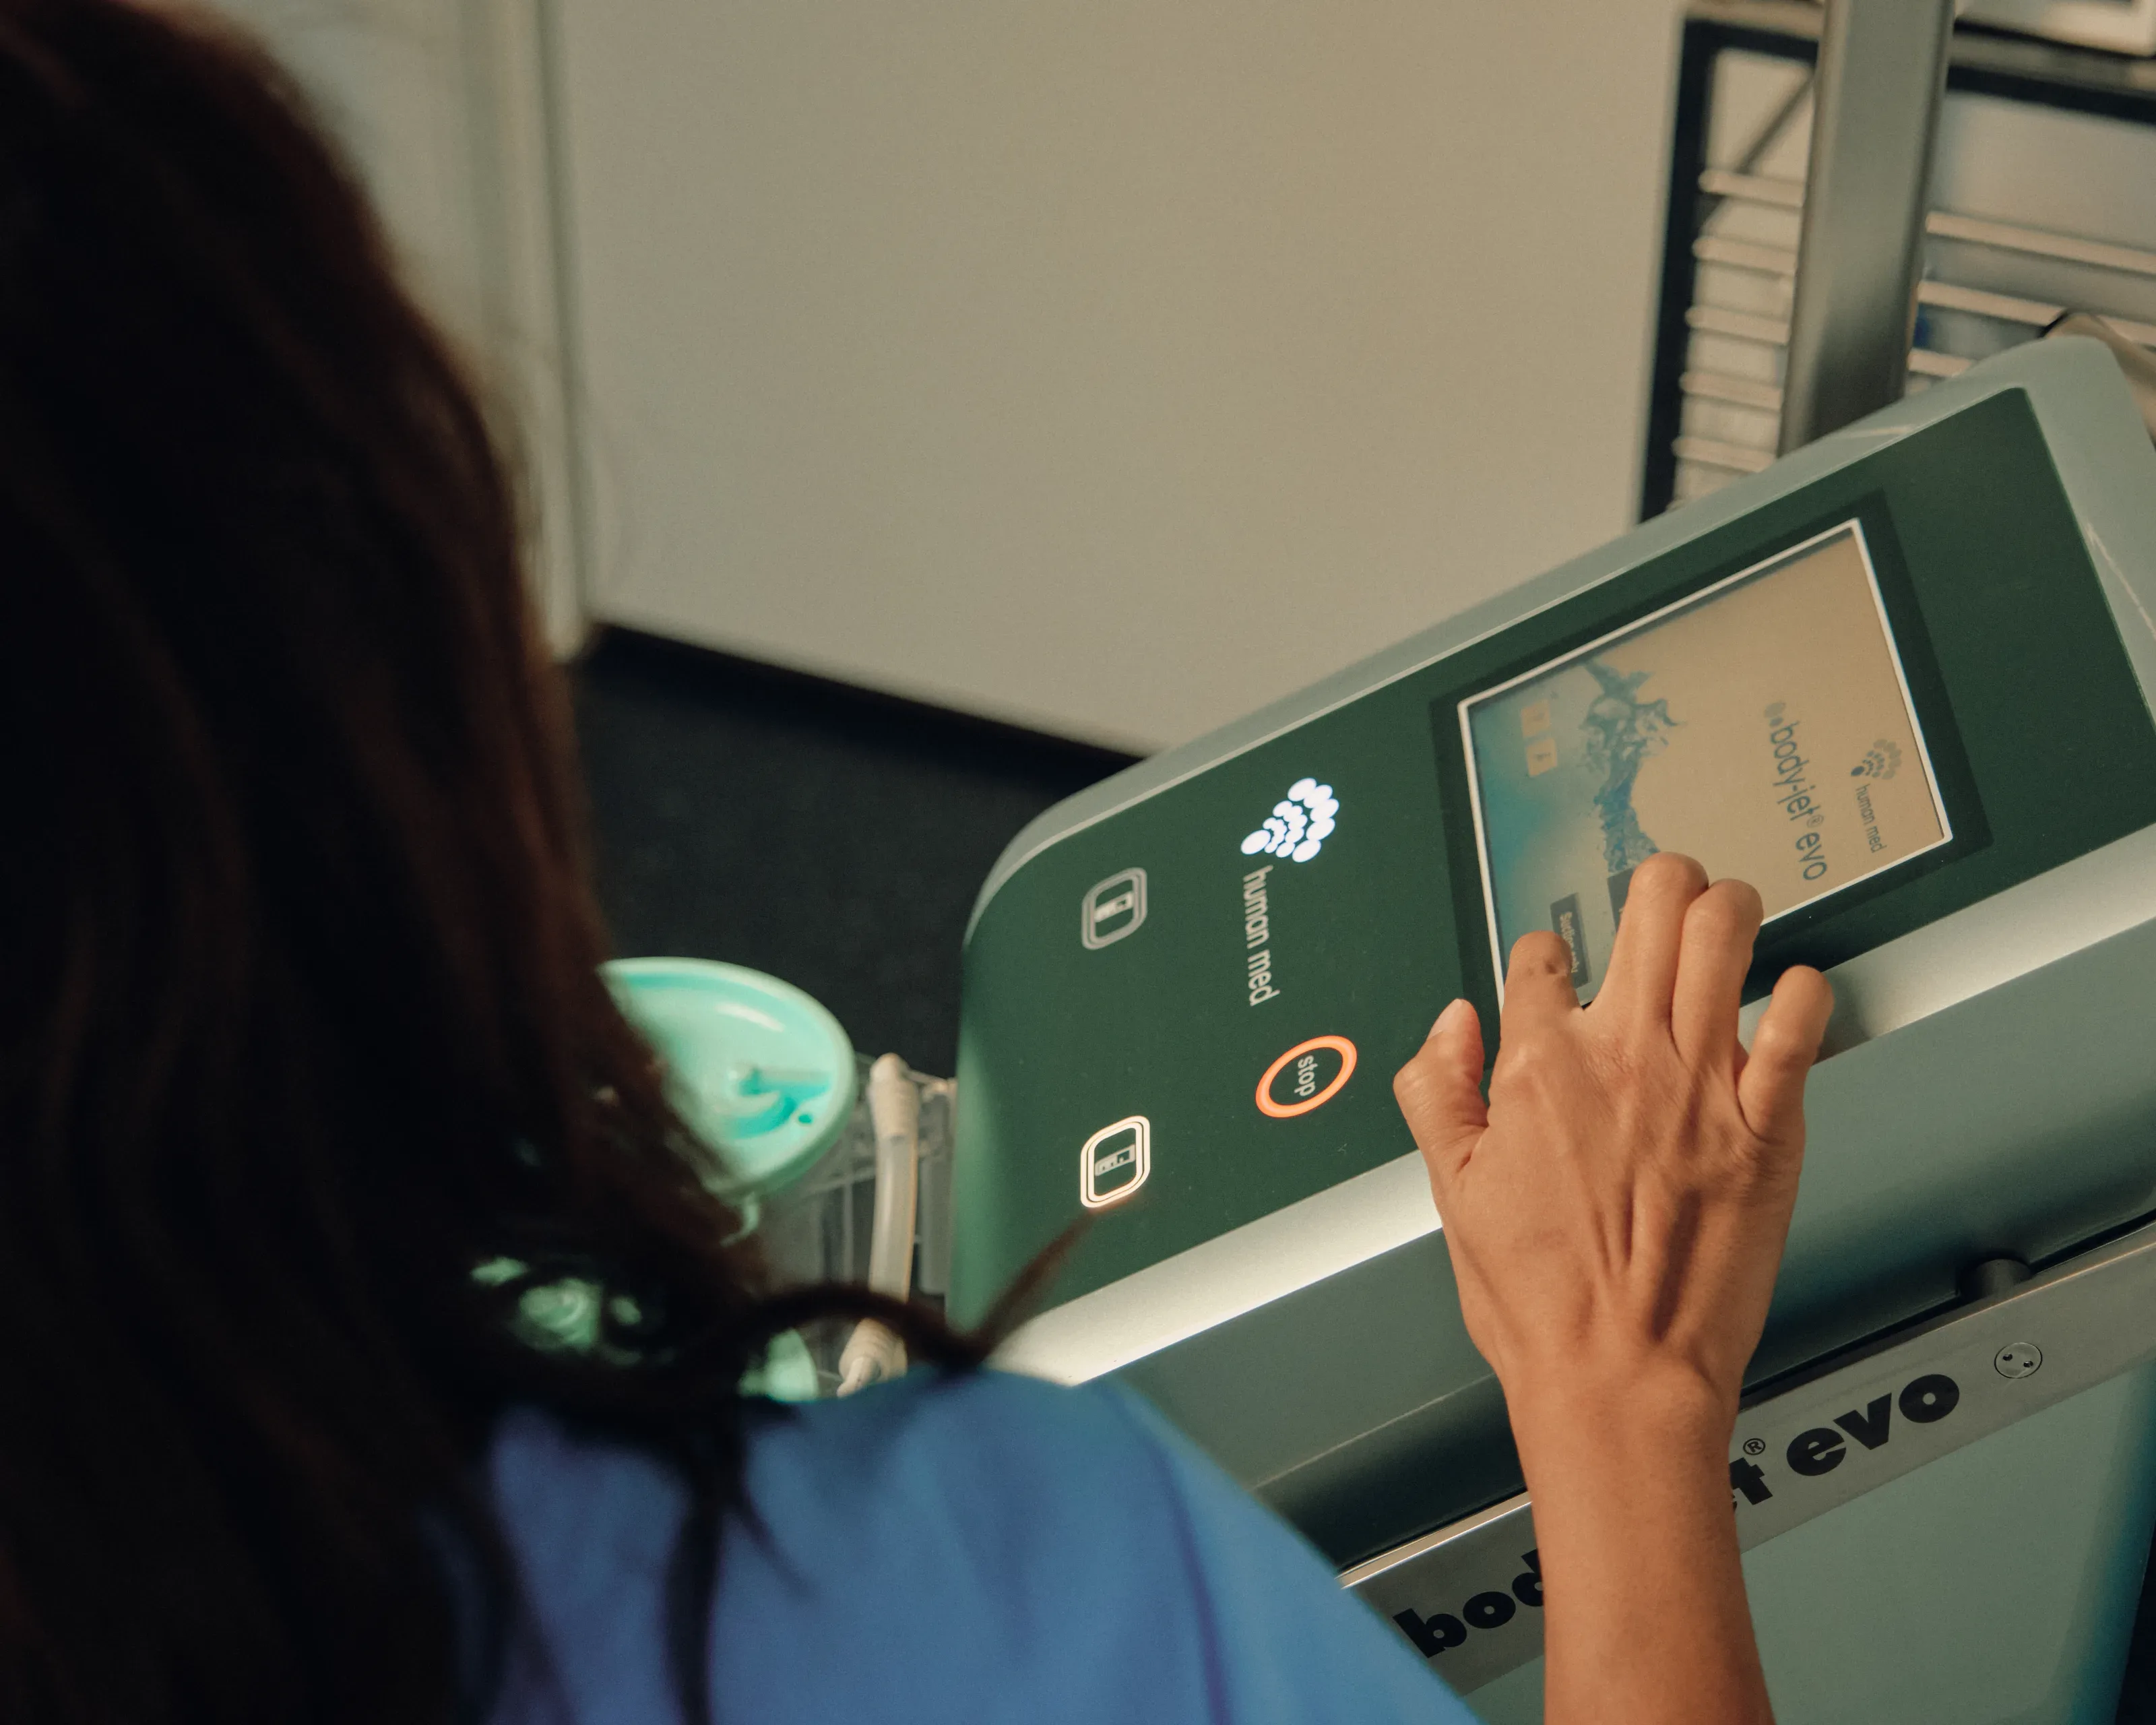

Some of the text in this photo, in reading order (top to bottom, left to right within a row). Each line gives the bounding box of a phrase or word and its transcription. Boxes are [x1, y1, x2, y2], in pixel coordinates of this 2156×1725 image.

[1856, 783, 1887, 854] human med
[1795, 832, 1828, 881] evo
[1242, 864, 1281, 1007] human med
[1294, 1055, 1317, 1097] stop
[1785, 1373, 1960, 1476] evo
